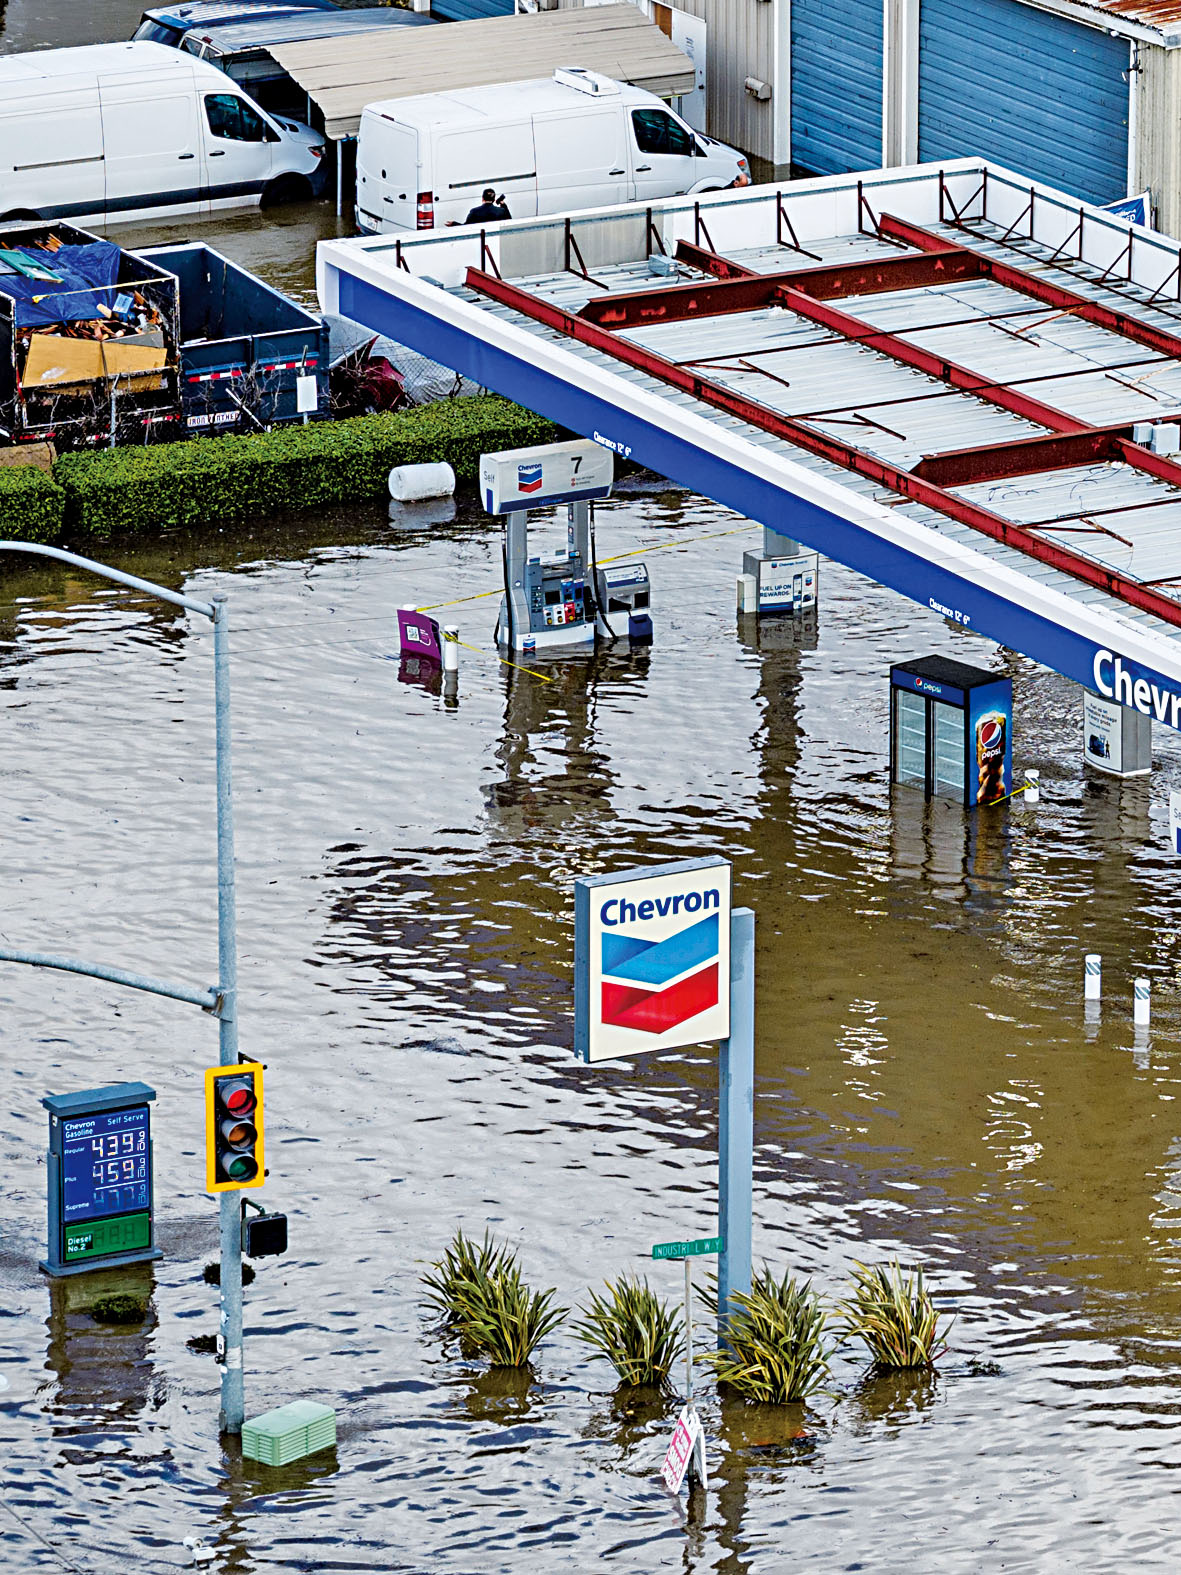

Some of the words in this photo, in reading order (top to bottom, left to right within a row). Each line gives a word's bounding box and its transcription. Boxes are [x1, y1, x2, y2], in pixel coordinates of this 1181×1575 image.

[518, 463, 542, 472] Chevron
[571, 456, 583, 474] 7
[484, 471, 495, 484] Self
[924, 683, 942, 693] pepsi
[982, 748, 1001, 760] pepsi
[601, 888, 720, 926] Chevron
[108, 1117, 121, 1125] Self
[124, 1114, 144, 1123] Serve
[65, 1121, 95, 1131] Chevron
[66, 1128, 93, 1139] Gasoline
[92, 1133, 134, 1157] 439
[65, 1147, 85, 1155] Regular
[93, 1160, 134, 1184] 459
[66, 1202, 90, 1211] Supreme
[68, 1235, 91, 1246] Diesel
